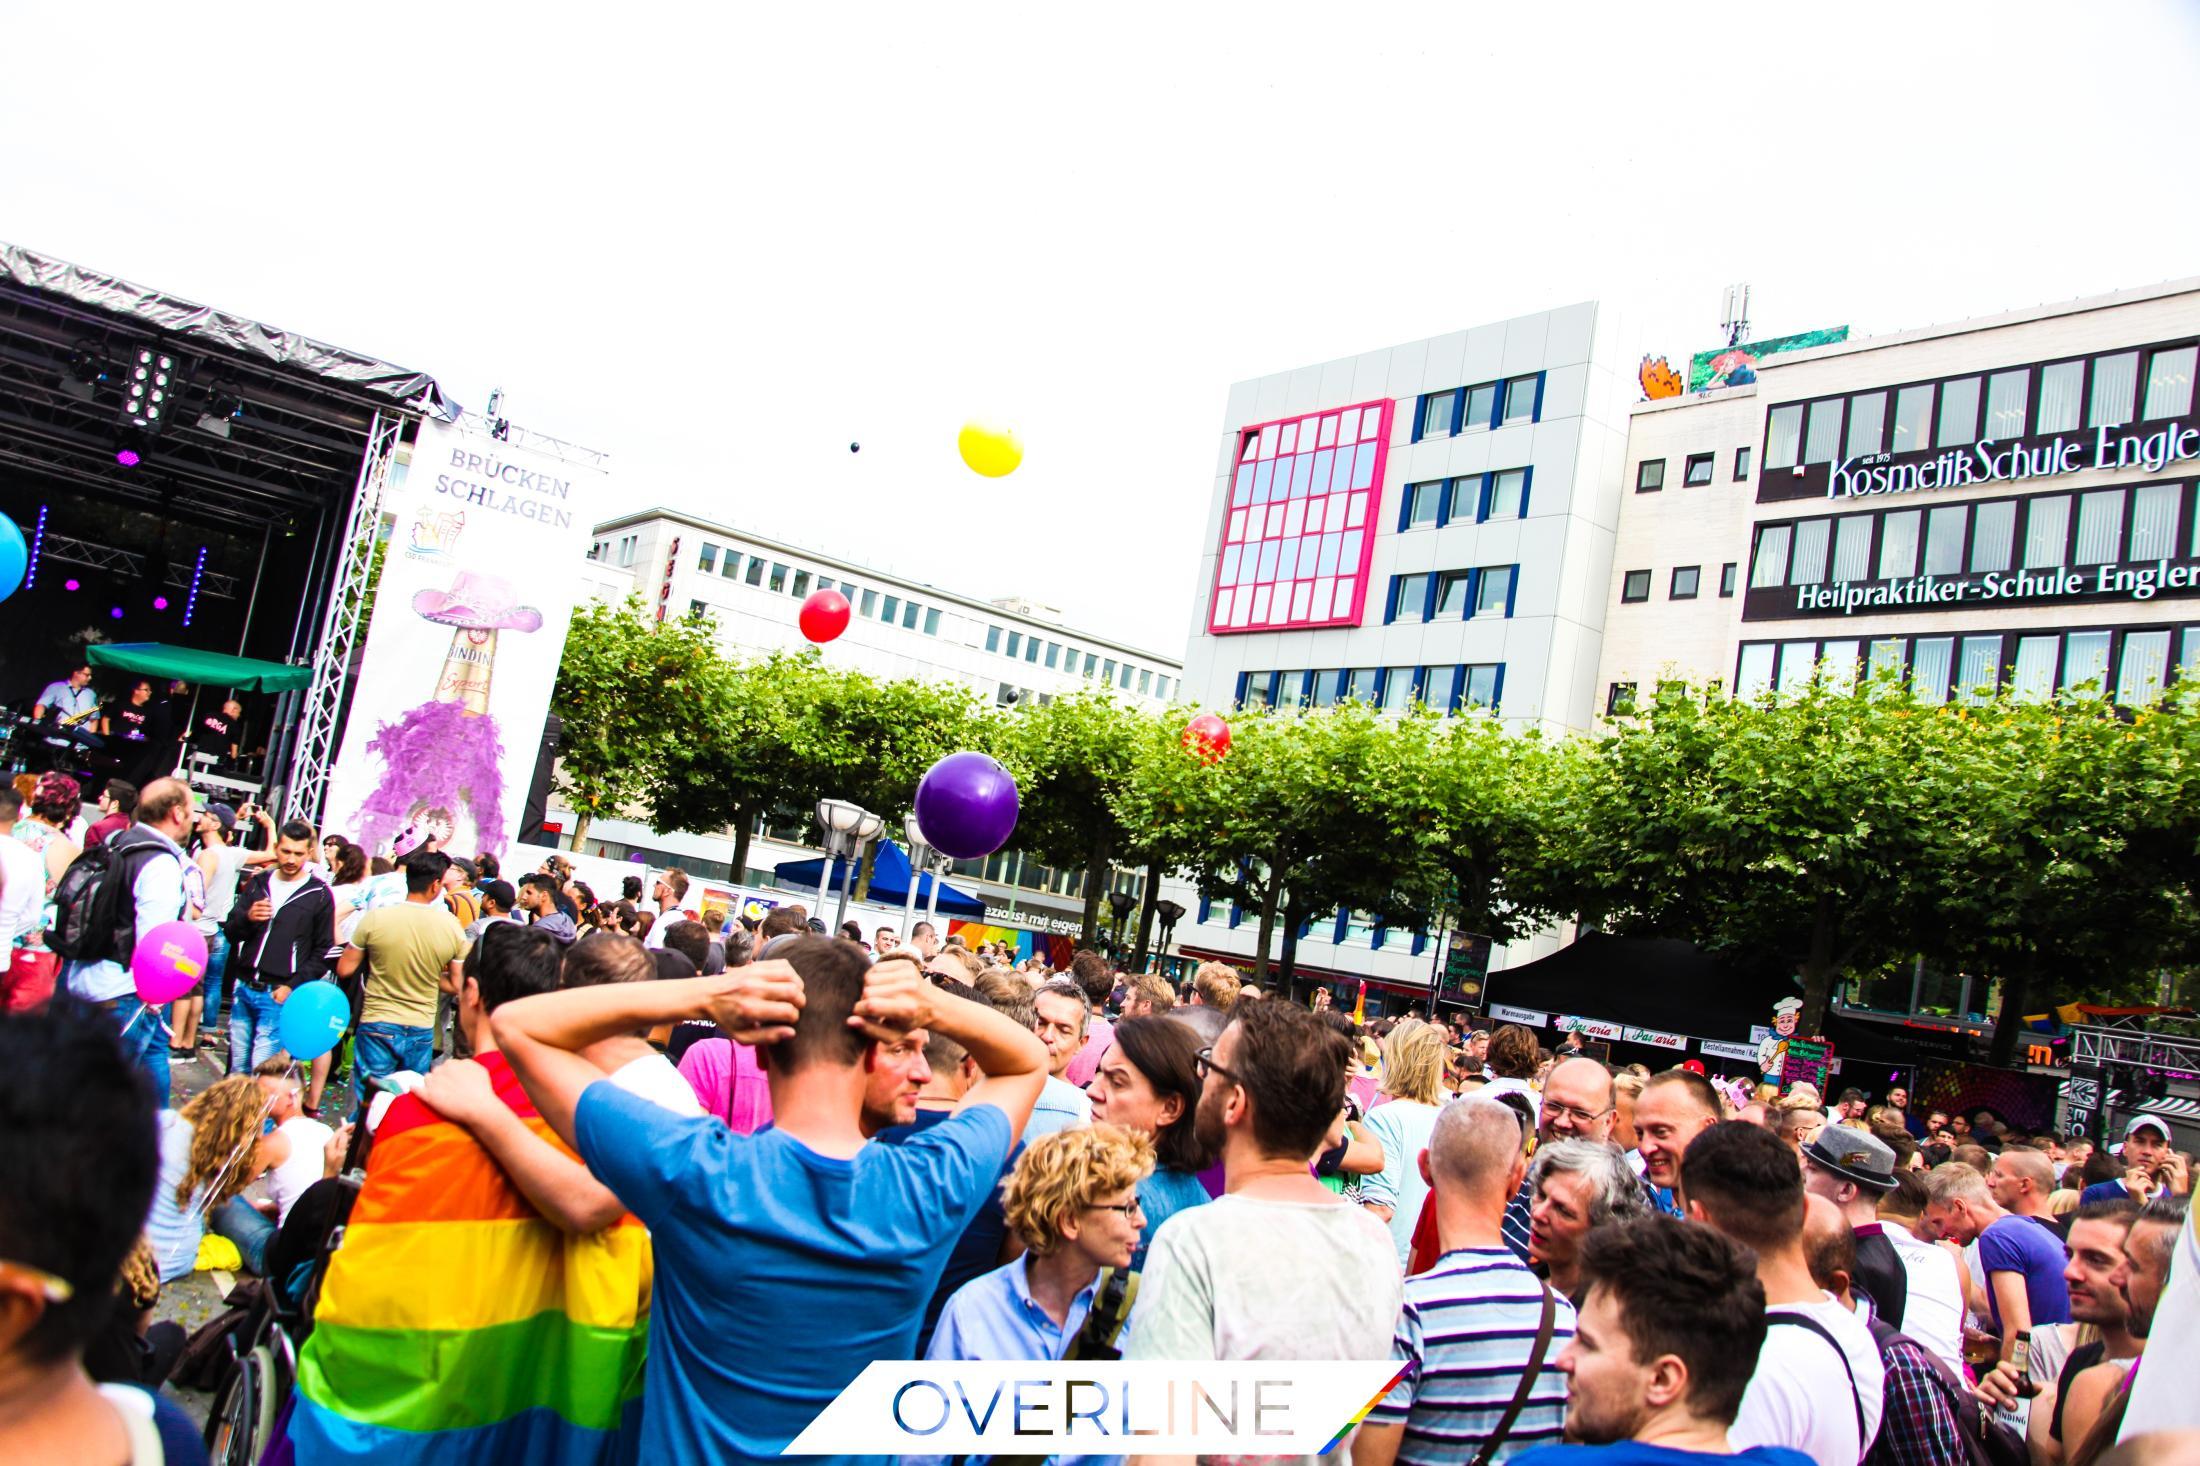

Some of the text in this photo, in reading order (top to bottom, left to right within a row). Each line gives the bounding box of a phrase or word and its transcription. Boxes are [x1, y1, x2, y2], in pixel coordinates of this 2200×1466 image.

[1862, 456, 1874, 465] seit
[449, 447, 571, 500] BRÜCKEN
[435, 474, 572, 529] SCHLAGEN
[1796, 559, 2200, 614] Heilpraktiker-Schule Engler
[1028, 912, 1050, 928] mit
[1501, 1007, 1535, 1021] Warenausgabe
[1703, 1040, 1746, 1056] Bestellannahme
